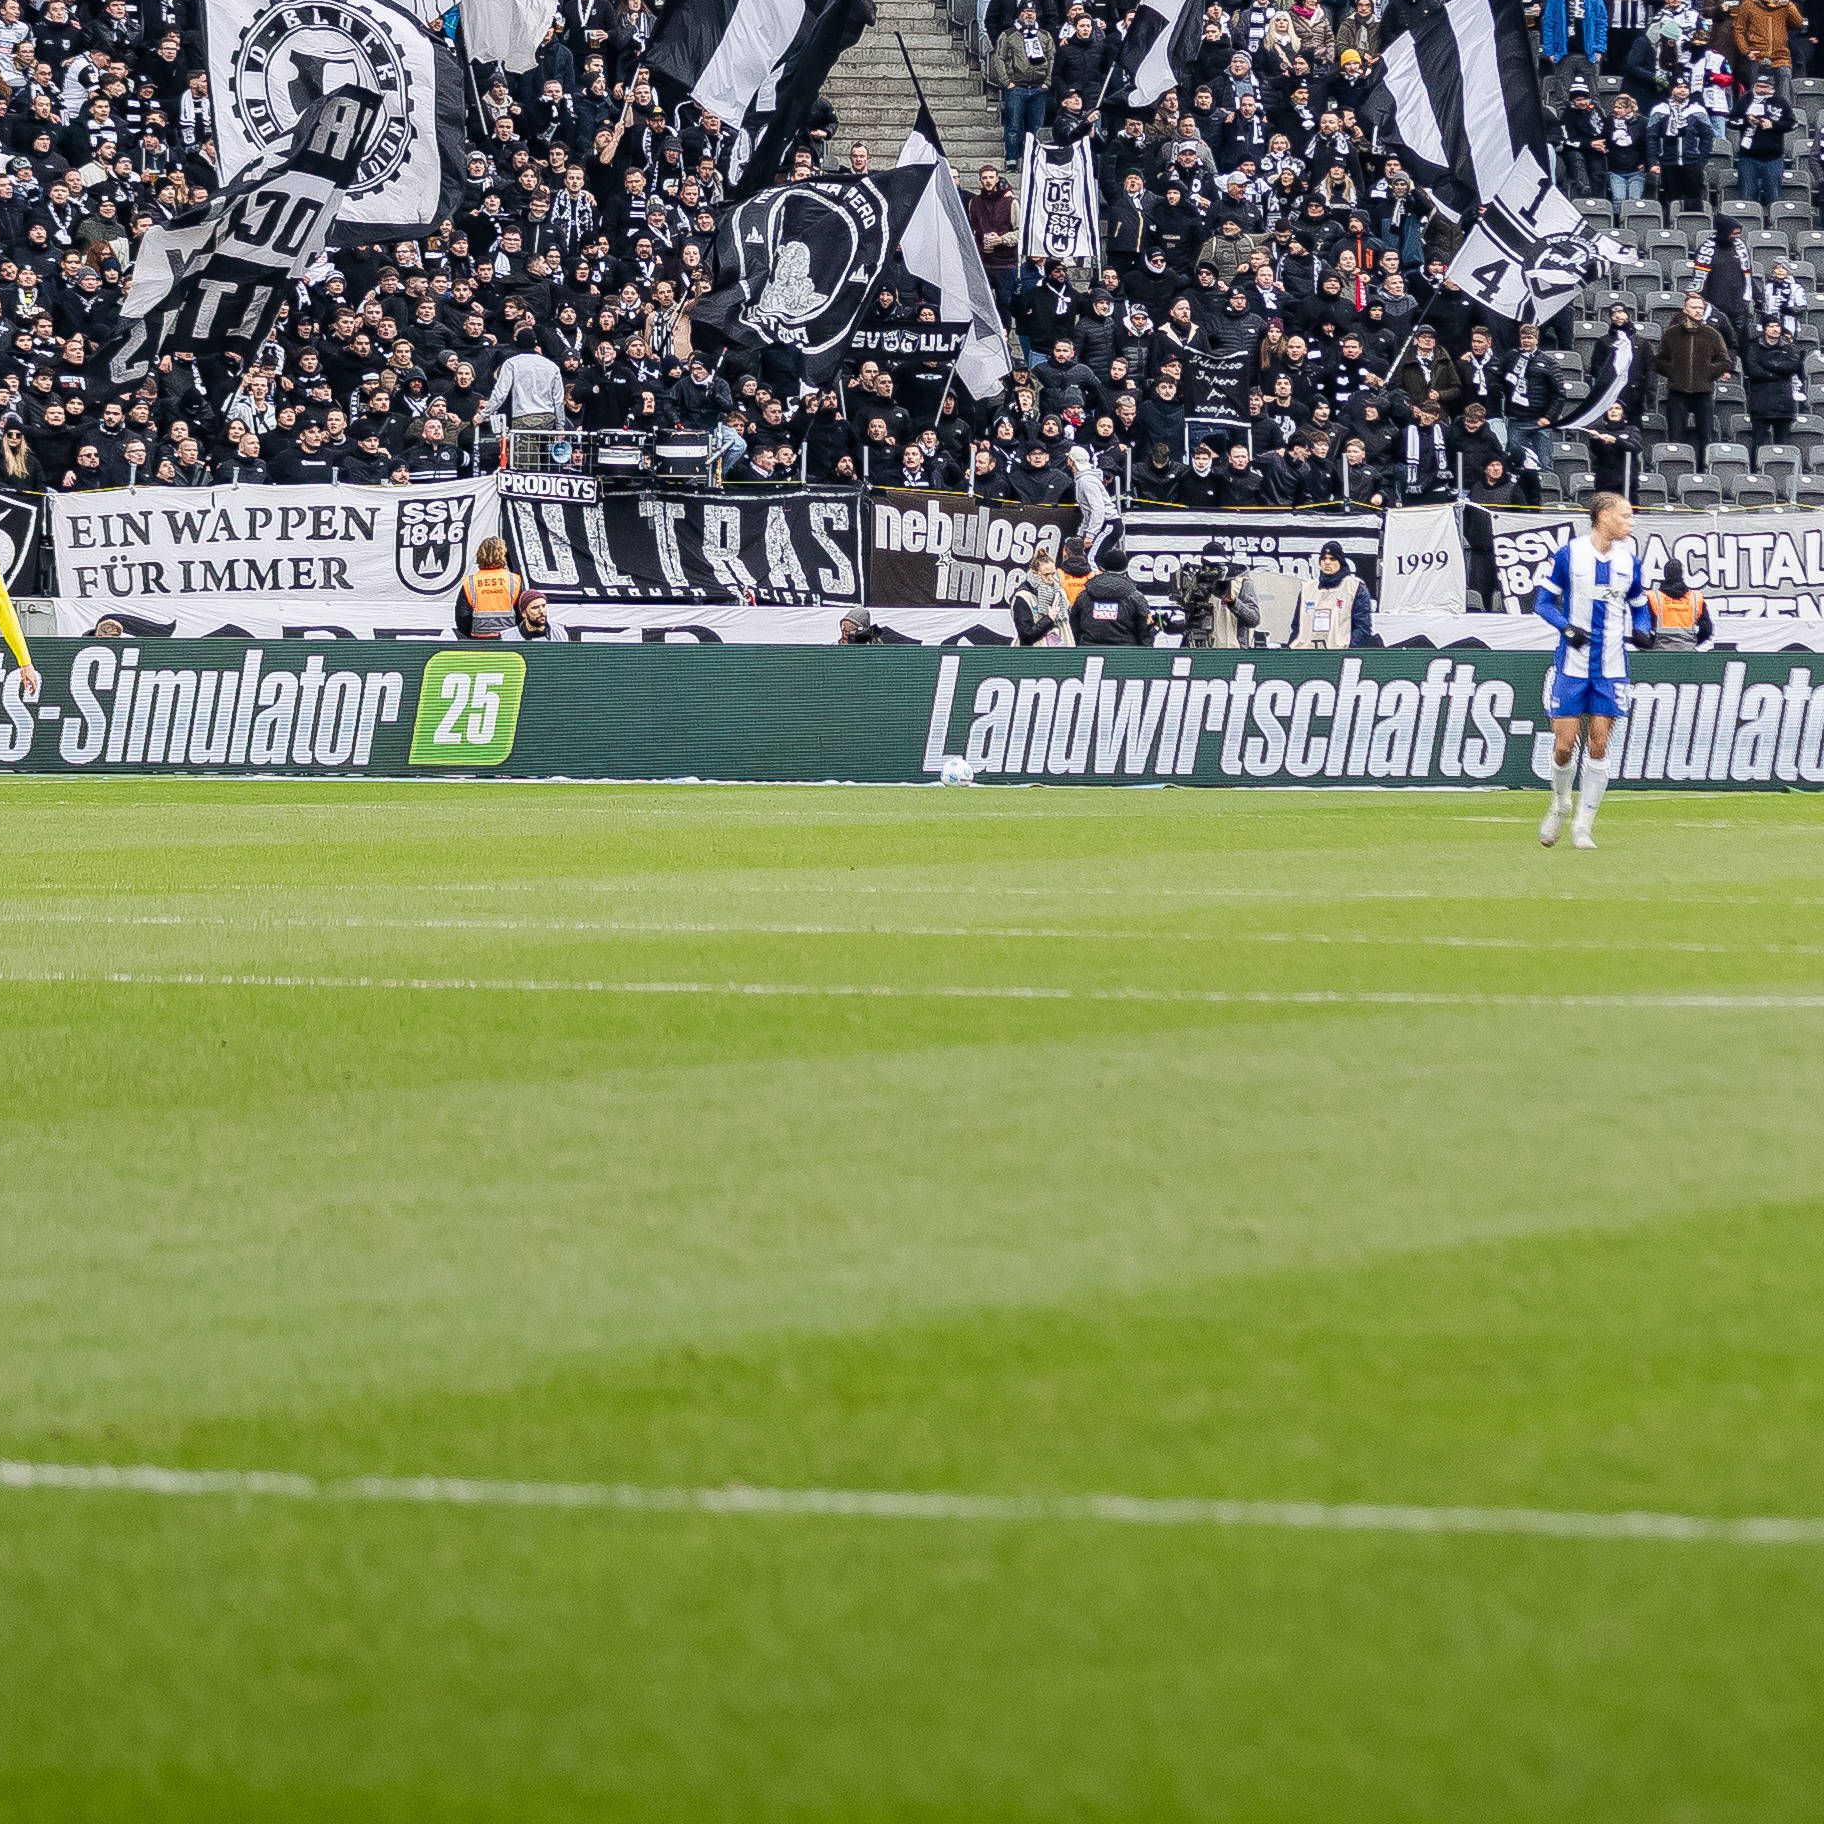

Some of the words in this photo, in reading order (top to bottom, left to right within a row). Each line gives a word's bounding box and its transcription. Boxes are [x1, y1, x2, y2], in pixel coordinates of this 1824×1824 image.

[1048, 224, 1077, 239] 1846
[1049, 215, 1080, 228] SSV
[500, 473, 596, 500] PRODIGYS
[402, 498, 473, 524] SSV
[65, 510, 154, 550] EIN
[161, 505, 381, 545] WAPPEN
[401, 521, 465, 547] 1846
[875, 499, 1062, 565] nebulosa
[514, 500, 856, 595] ULTRAS
[1494, 525, 1575, 567] SSV
[76, 554, 172, 599] FÜR
[178, 556, 356, 595] IMMER
[1394, 550, 1450, 576] 1999
[477, 577, 505, 588] BEST
[433, 672, 505, 746] 25
